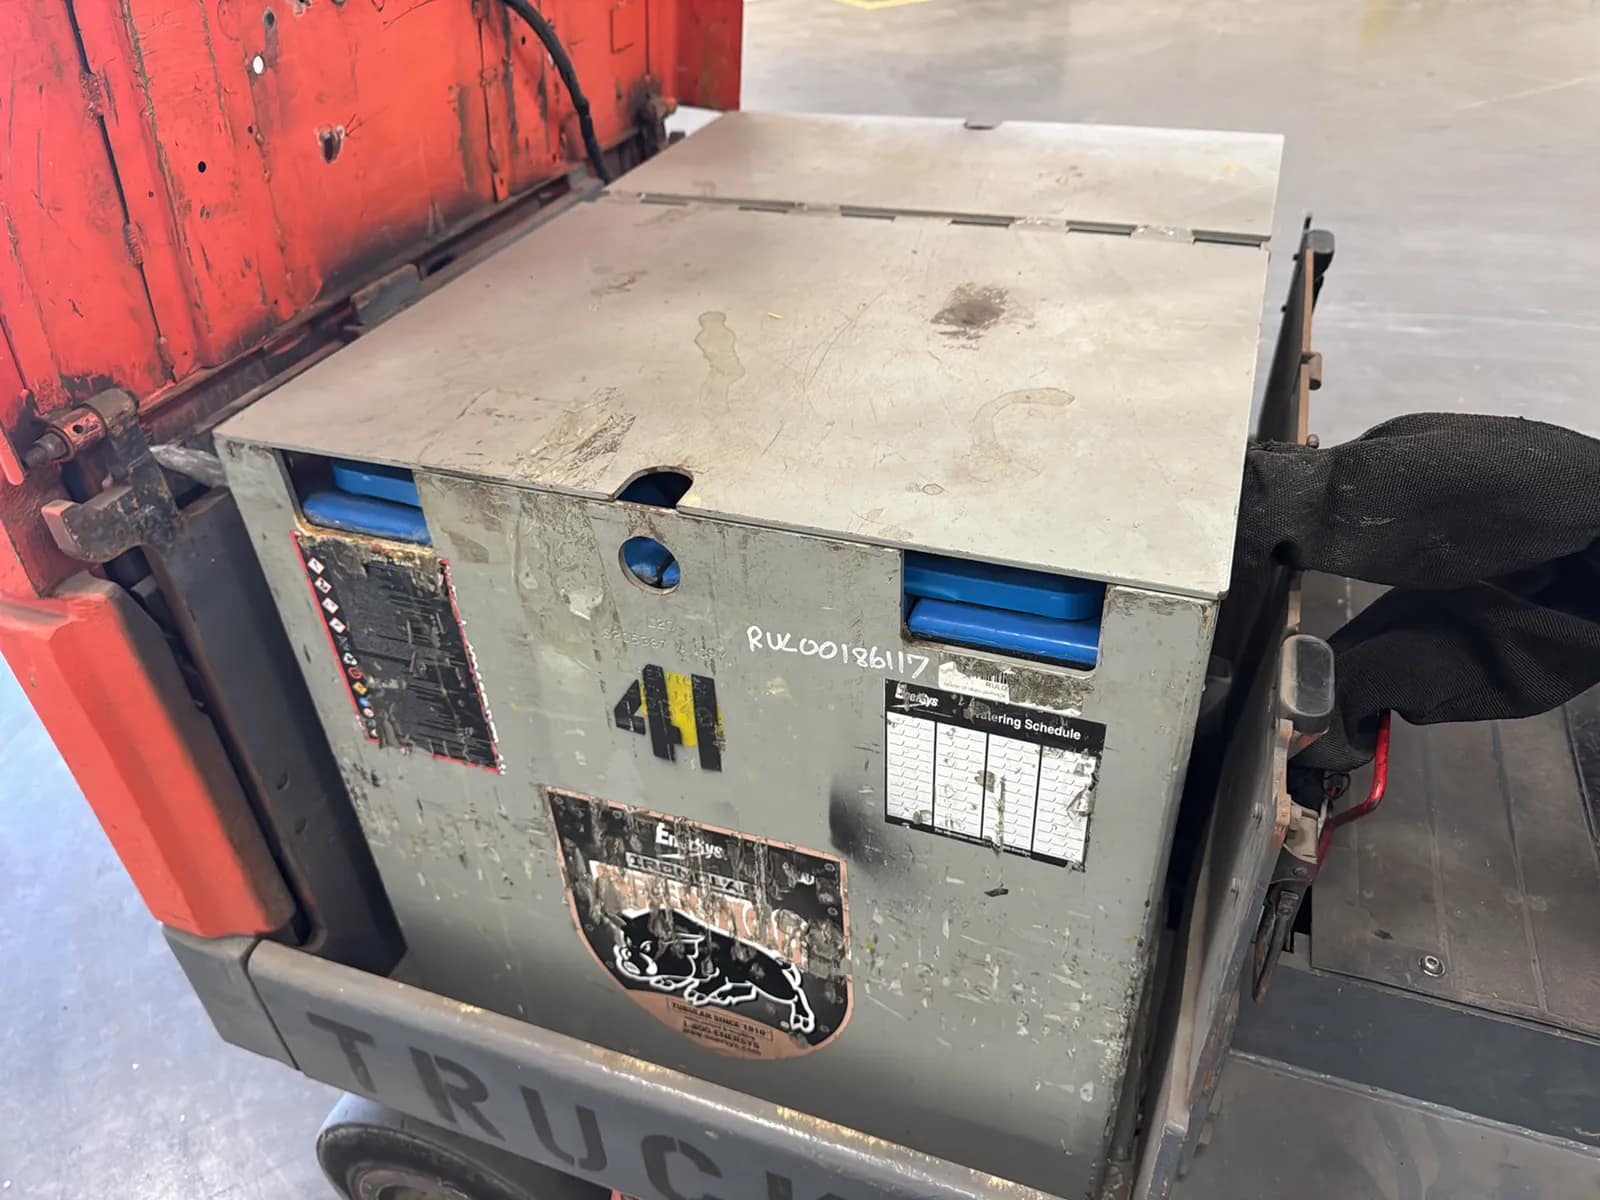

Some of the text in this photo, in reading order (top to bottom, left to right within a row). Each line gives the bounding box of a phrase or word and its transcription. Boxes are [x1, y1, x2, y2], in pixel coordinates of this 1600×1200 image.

[746, 625, 930, 679] RUL00186117
[971, 703, 1082, 742] atering Schedule
